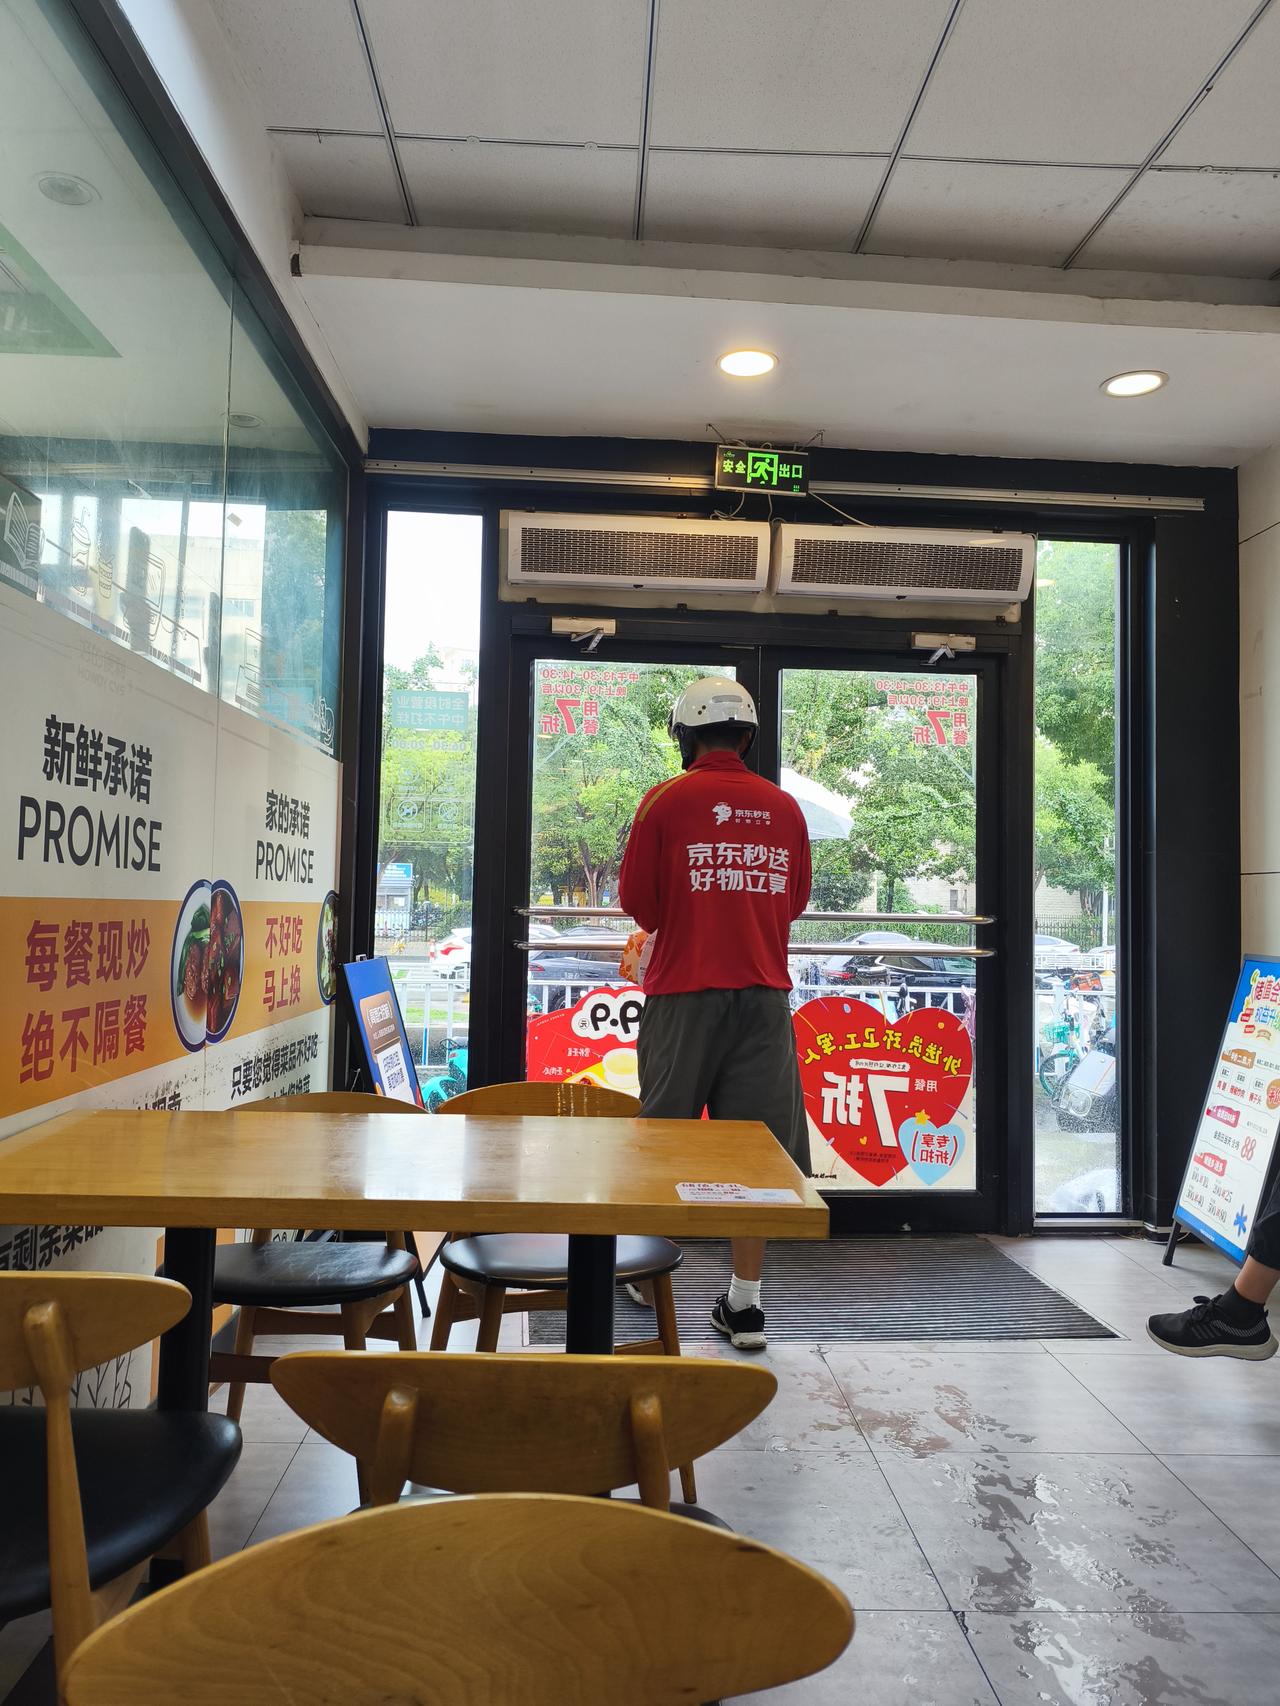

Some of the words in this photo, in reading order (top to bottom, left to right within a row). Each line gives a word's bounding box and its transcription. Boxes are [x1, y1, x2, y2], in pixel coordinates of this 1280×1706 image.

[723, 459, 746, 474] 安全
[779, 464, 802, 478] 出口
[42, 714, 153, 804] 新鲜承诺
[17, 796, 162, 872] PROMISE
[265, 789, 311, 840] 家的承诺
[255, 840, 315, 884] PROMISE
[686, 842, 790, 872] 京东秒送
[689, 868, 788, 895] 好物立享
[25, 918, 151, 992] 每餐现炒
[265, 915, 303, 959] 不好吃
[262, 964, 301, 1012] 马上换
[19, 994, 148, 1083] 绝不隔餐
[231, 1032, 319, 1100] 只要您觉得菜品不好吃
